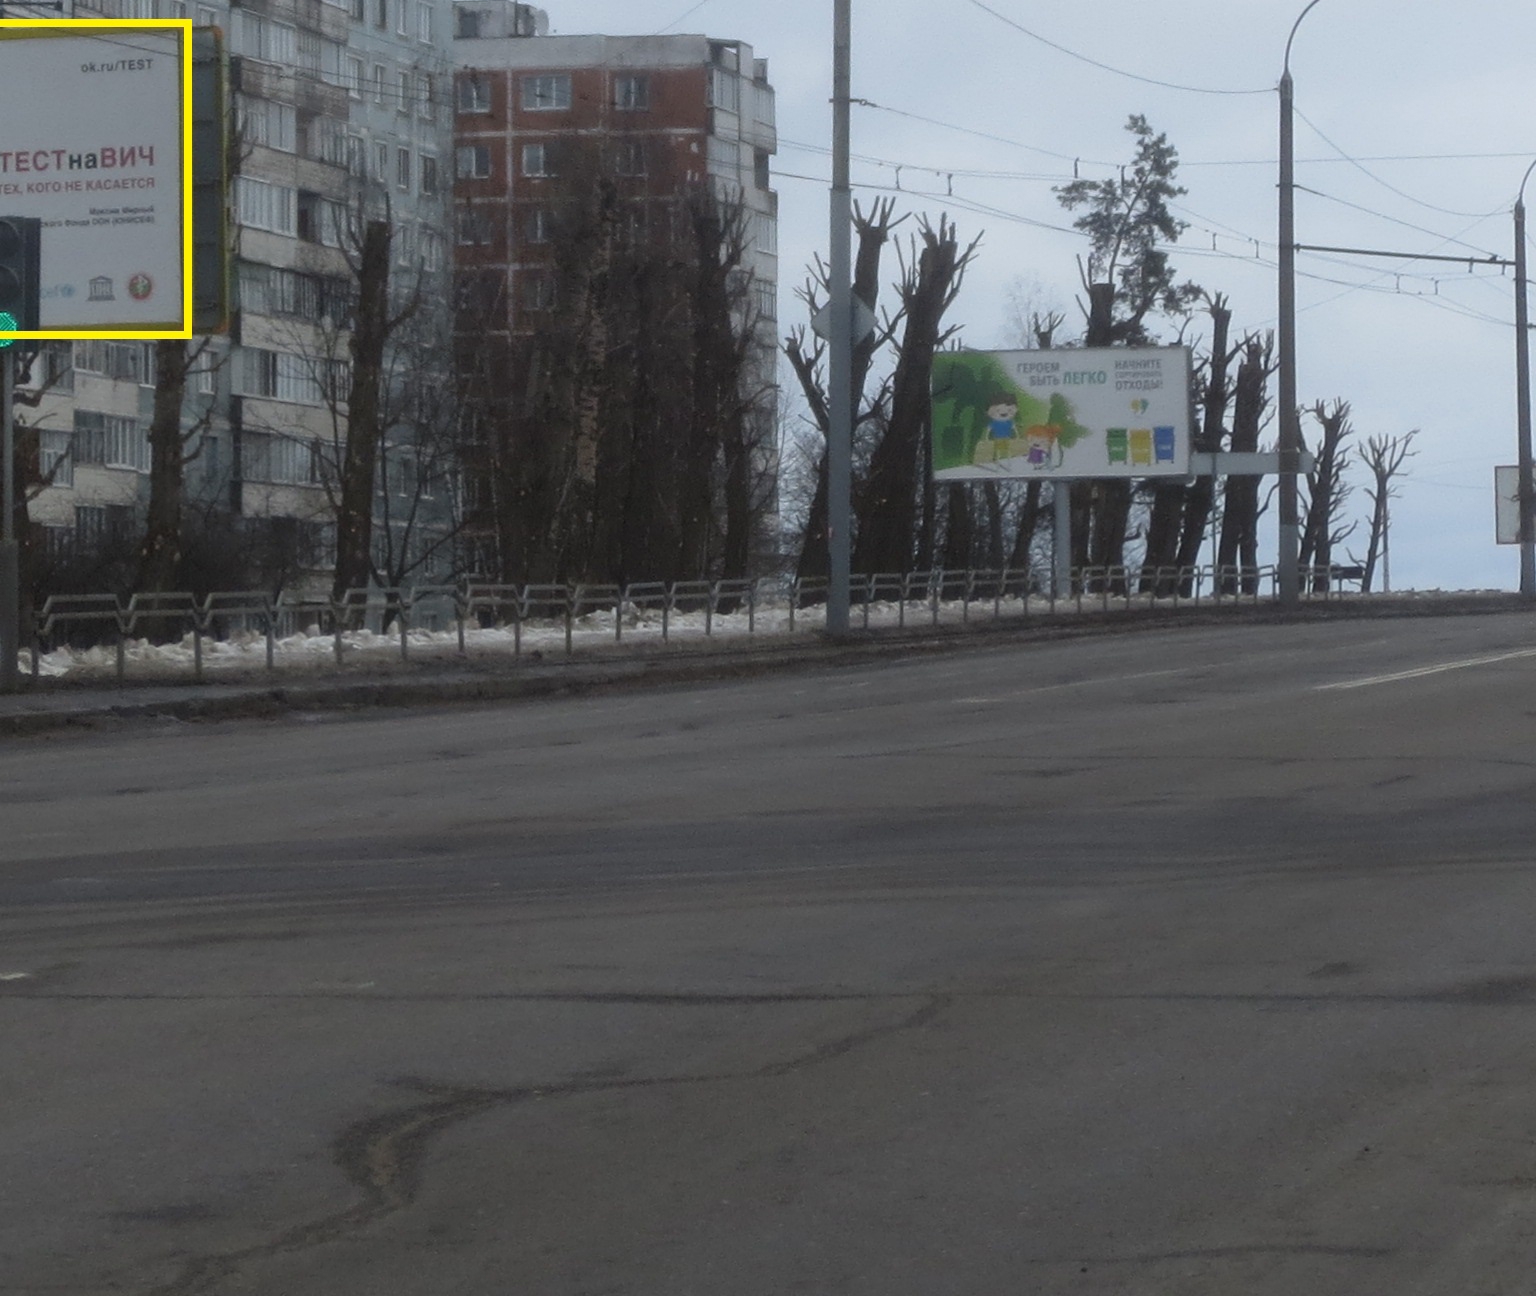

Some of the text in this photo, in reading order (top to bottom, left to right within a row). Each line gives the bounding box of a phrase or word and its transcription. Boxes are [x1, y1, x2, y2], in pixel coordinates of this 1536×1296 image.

[80, 58, 154, 73] ok.ru/TEST
[27, 180, 61, 194] КОГО
[65, 180, 82, 192] НЕ
[86, 177, 156, 191] КАСАЕТСЯ
[1016, 362, 1060, 374] ГЕРОЕМ
[1114, 359, 1162, 370] НАЧНИТЕ
[1030, 370, 1108, 386] БЫТЬ ЛЕГКО
